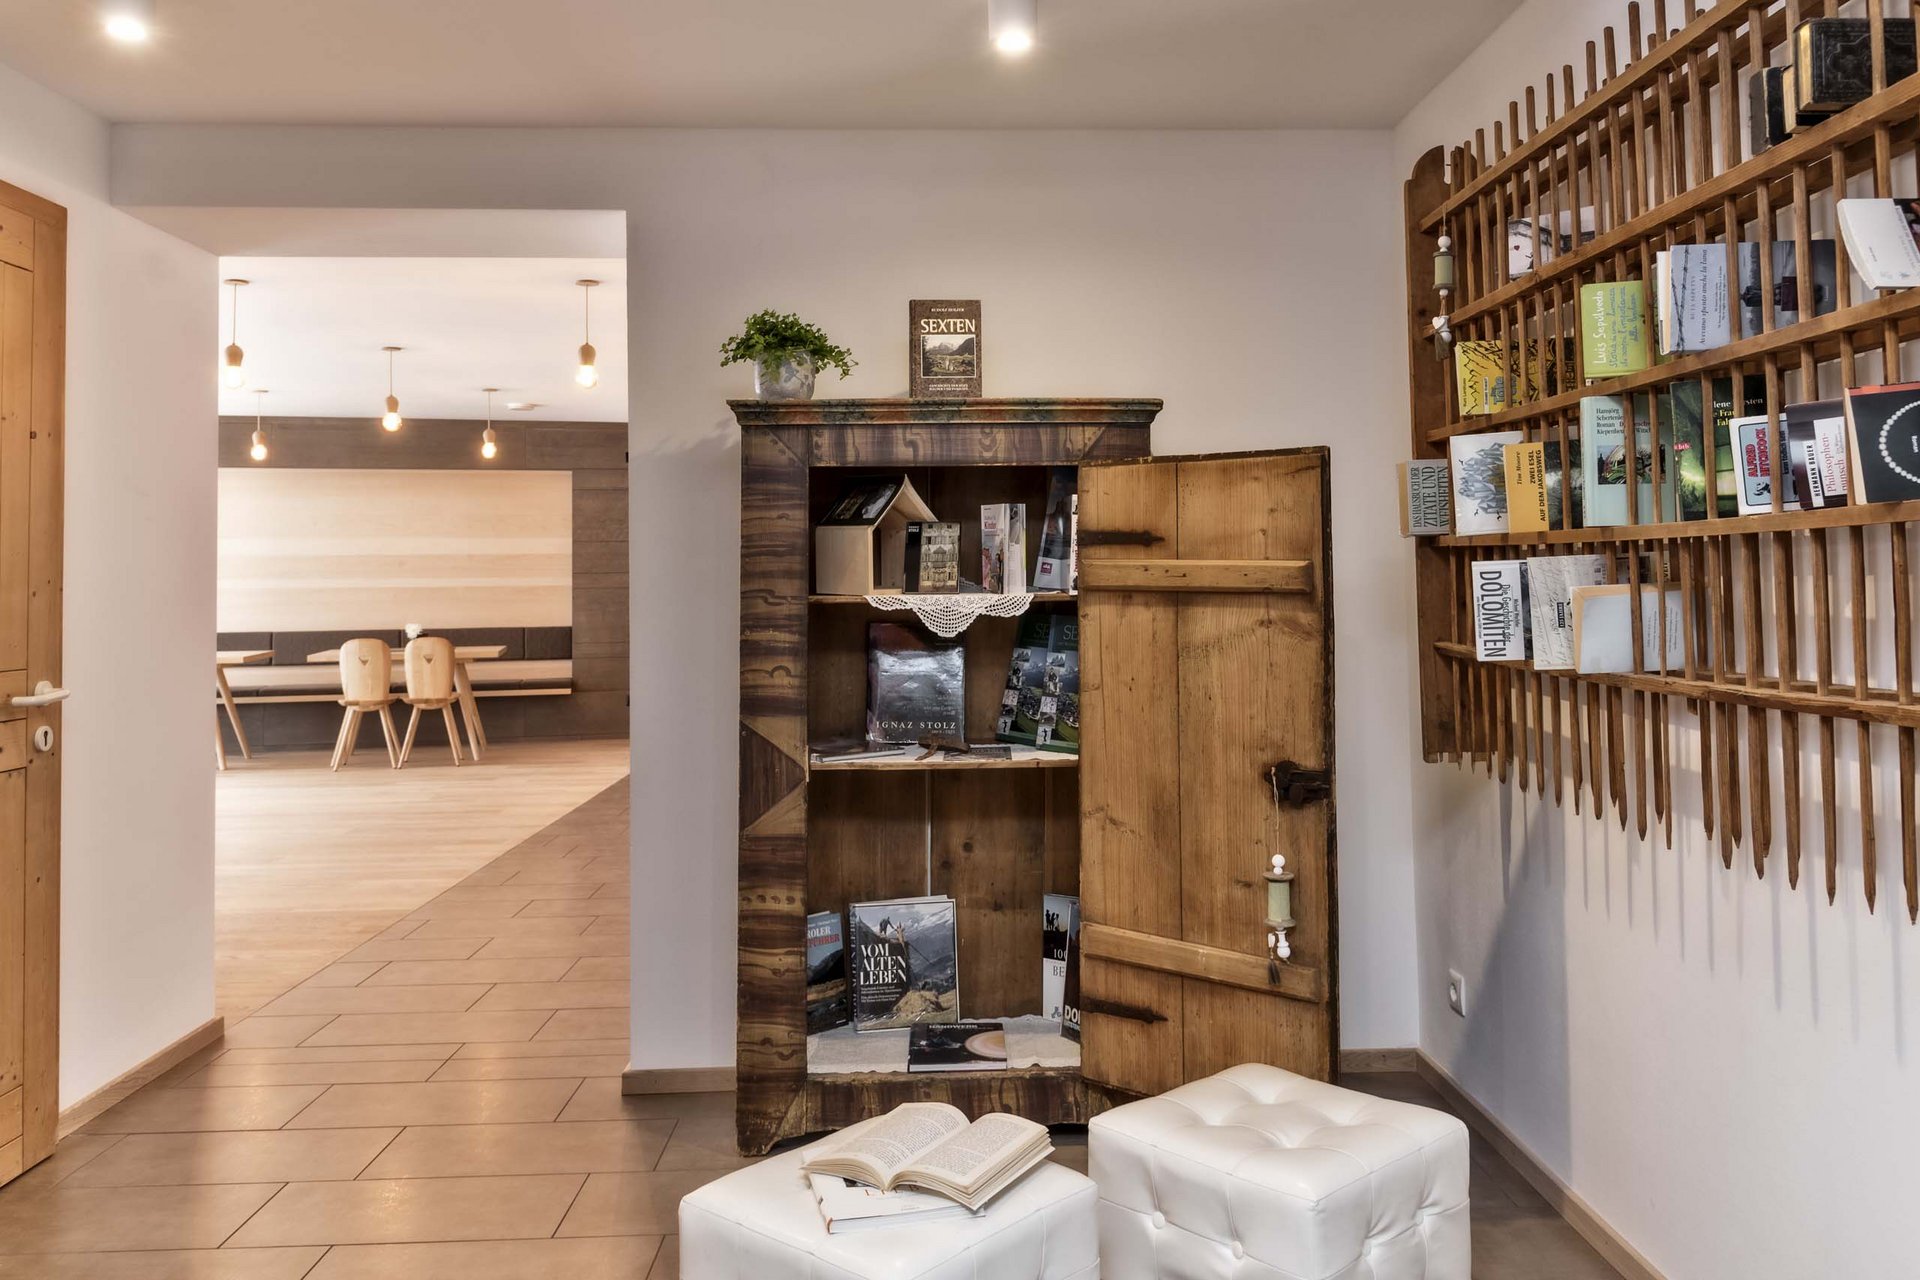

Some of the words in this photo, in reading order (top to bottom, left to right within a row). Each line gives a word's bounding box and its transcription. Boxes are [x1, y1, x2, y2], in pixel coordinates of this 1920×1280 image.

[920, 318, 976, 333] SEXTEN
[1593, 343, 1606, 364] Luis
[1713, 400, 1731, 409] lene
[1746, 443, 1758, 478] ALFRED
[1756, 427, 1770, 478] HITCHCOCK
[1806, 444, 1816, 465] BAUER
[1411, 466, 1420, 480] DER
[1421, 466, 1437, 489] UND
[1536, 449, 1544, 490] JAKOBSWEG
[1810, 467, 1821, 497] HERMANN
[1422, 492, 1438, 528] ZITATE
[1413, 515, 1422, 528] DAS
[1502, 584, 1511, 595] Die
[1479, 570, 1507, 658] DOLOMITEN
[1502, 597, 1513, 630] Geschichte
[1503, 631, 1514, 643] der
[876, 721, 913, 729] IGNAZ
[920, 721, 956, 729] STOLZ
[861, 943, 889, 958] VOM
[862, 955, 906, 971] ALTEN
[860, 969, 907, 985] LEBEN
